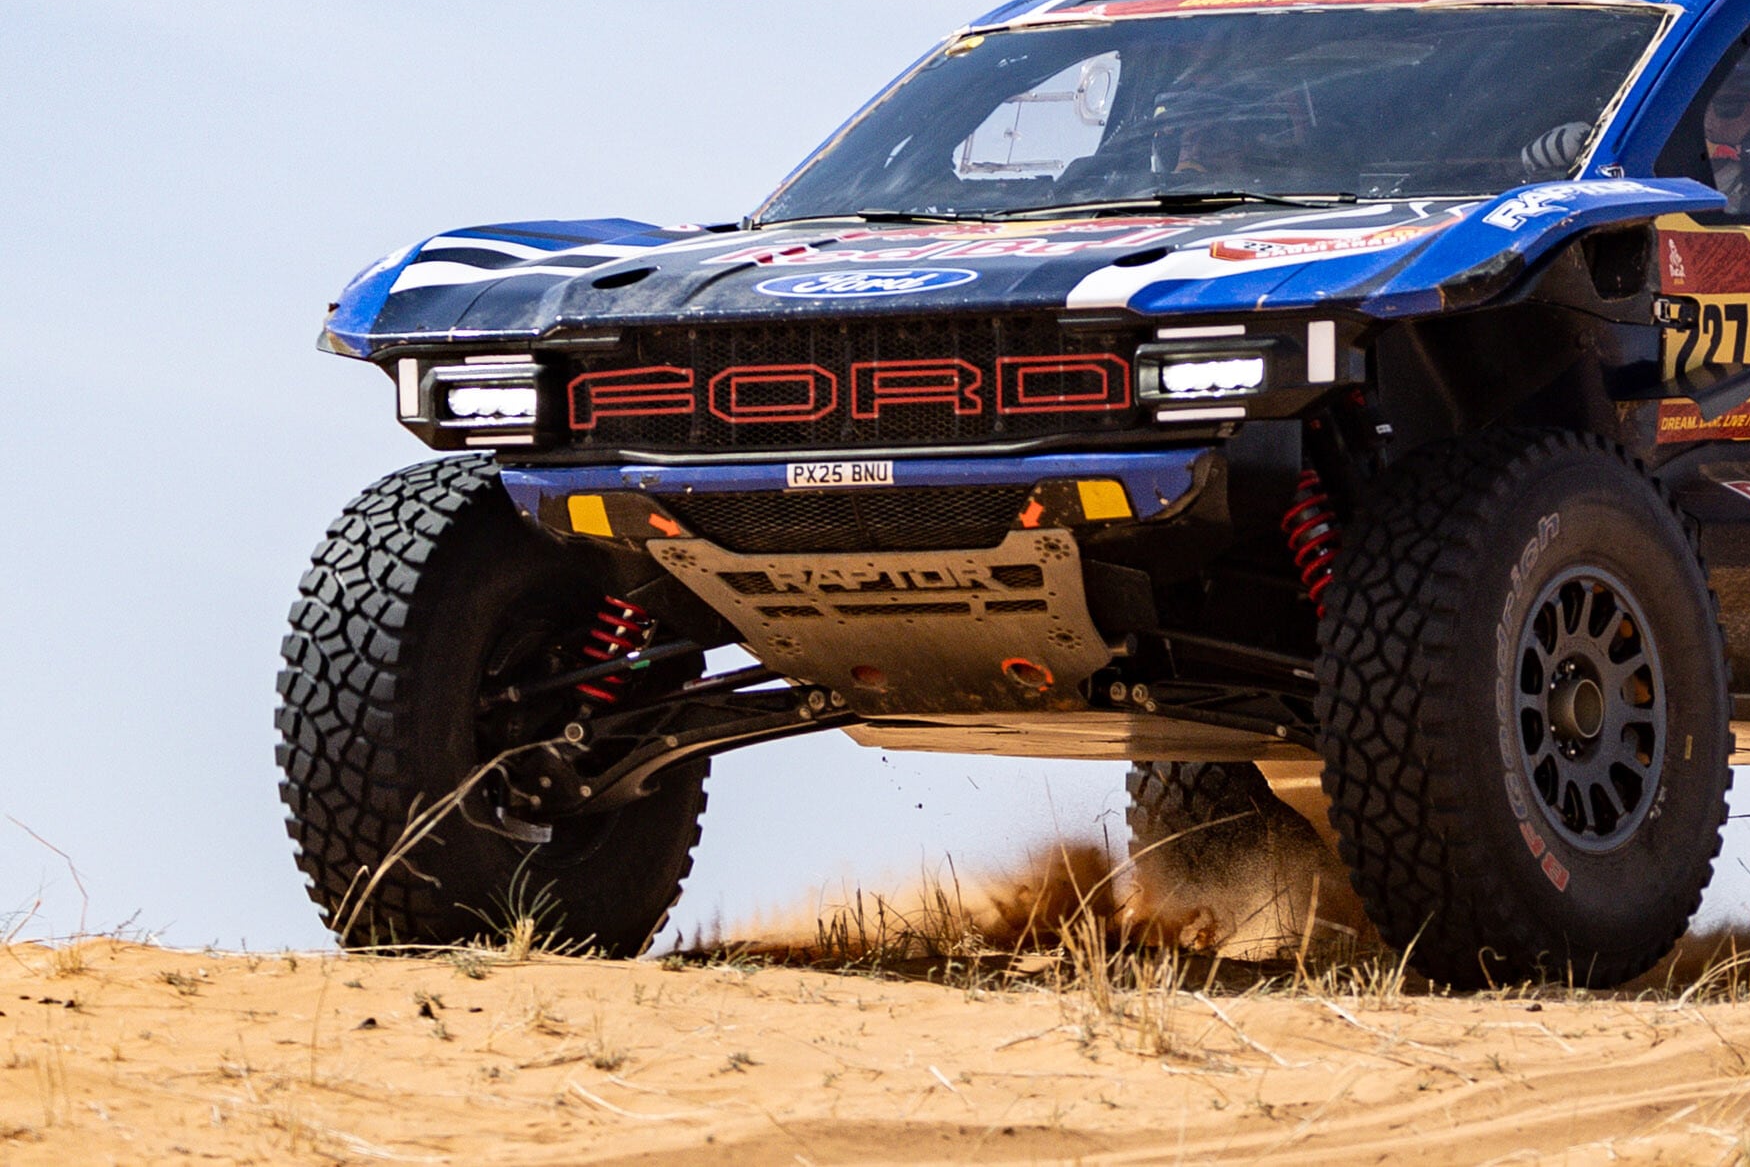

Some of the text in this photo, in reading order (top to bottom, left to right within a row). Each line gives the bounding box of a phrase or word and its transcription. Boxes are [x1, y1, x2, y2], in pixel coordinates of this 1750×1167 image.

[800, 269, 939, 293] Ford
[568, 353, 1131, 431] FORD
[1660, 415, 1698, 431] DREAM.
[1723, 414, 1746, 427] LIVE
[793, 462, 888, 484] PX25 BNU
[769, 562, 1000, 594] RAPTOR
